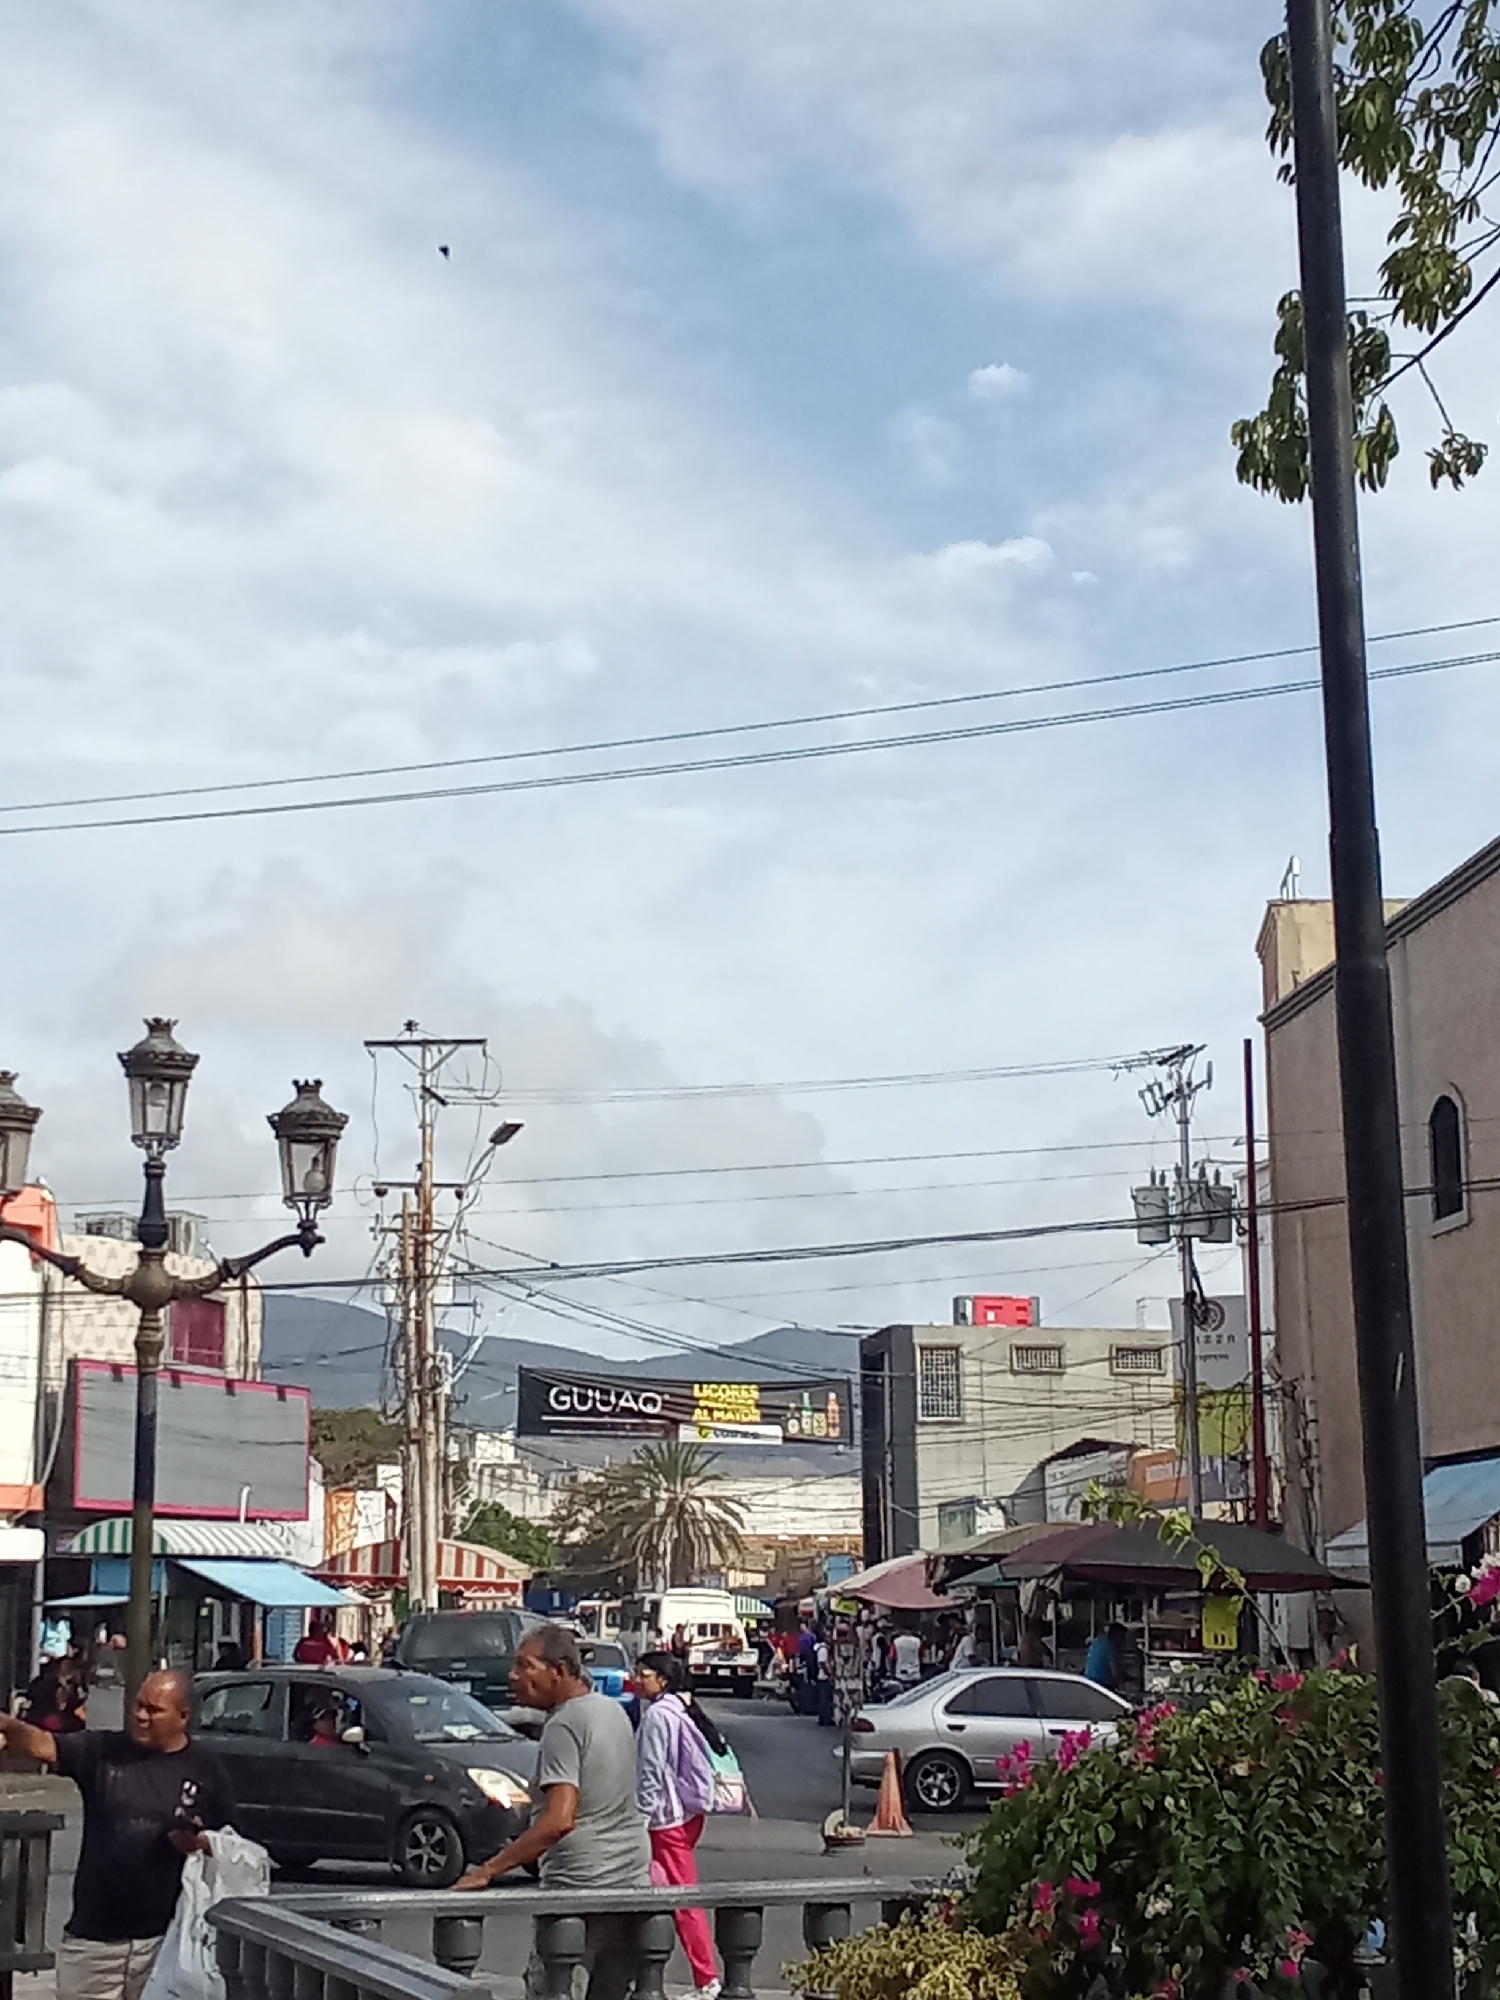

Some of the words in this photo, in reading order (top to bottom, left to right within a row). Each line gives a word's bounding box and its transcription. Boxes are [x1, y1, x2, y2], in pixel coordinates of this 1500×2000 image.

[693, 1383, 760, 1399] LICORES
[692, 1408, 711, 1421] AL
[713, 1409, 761, 1422] MAYOR
